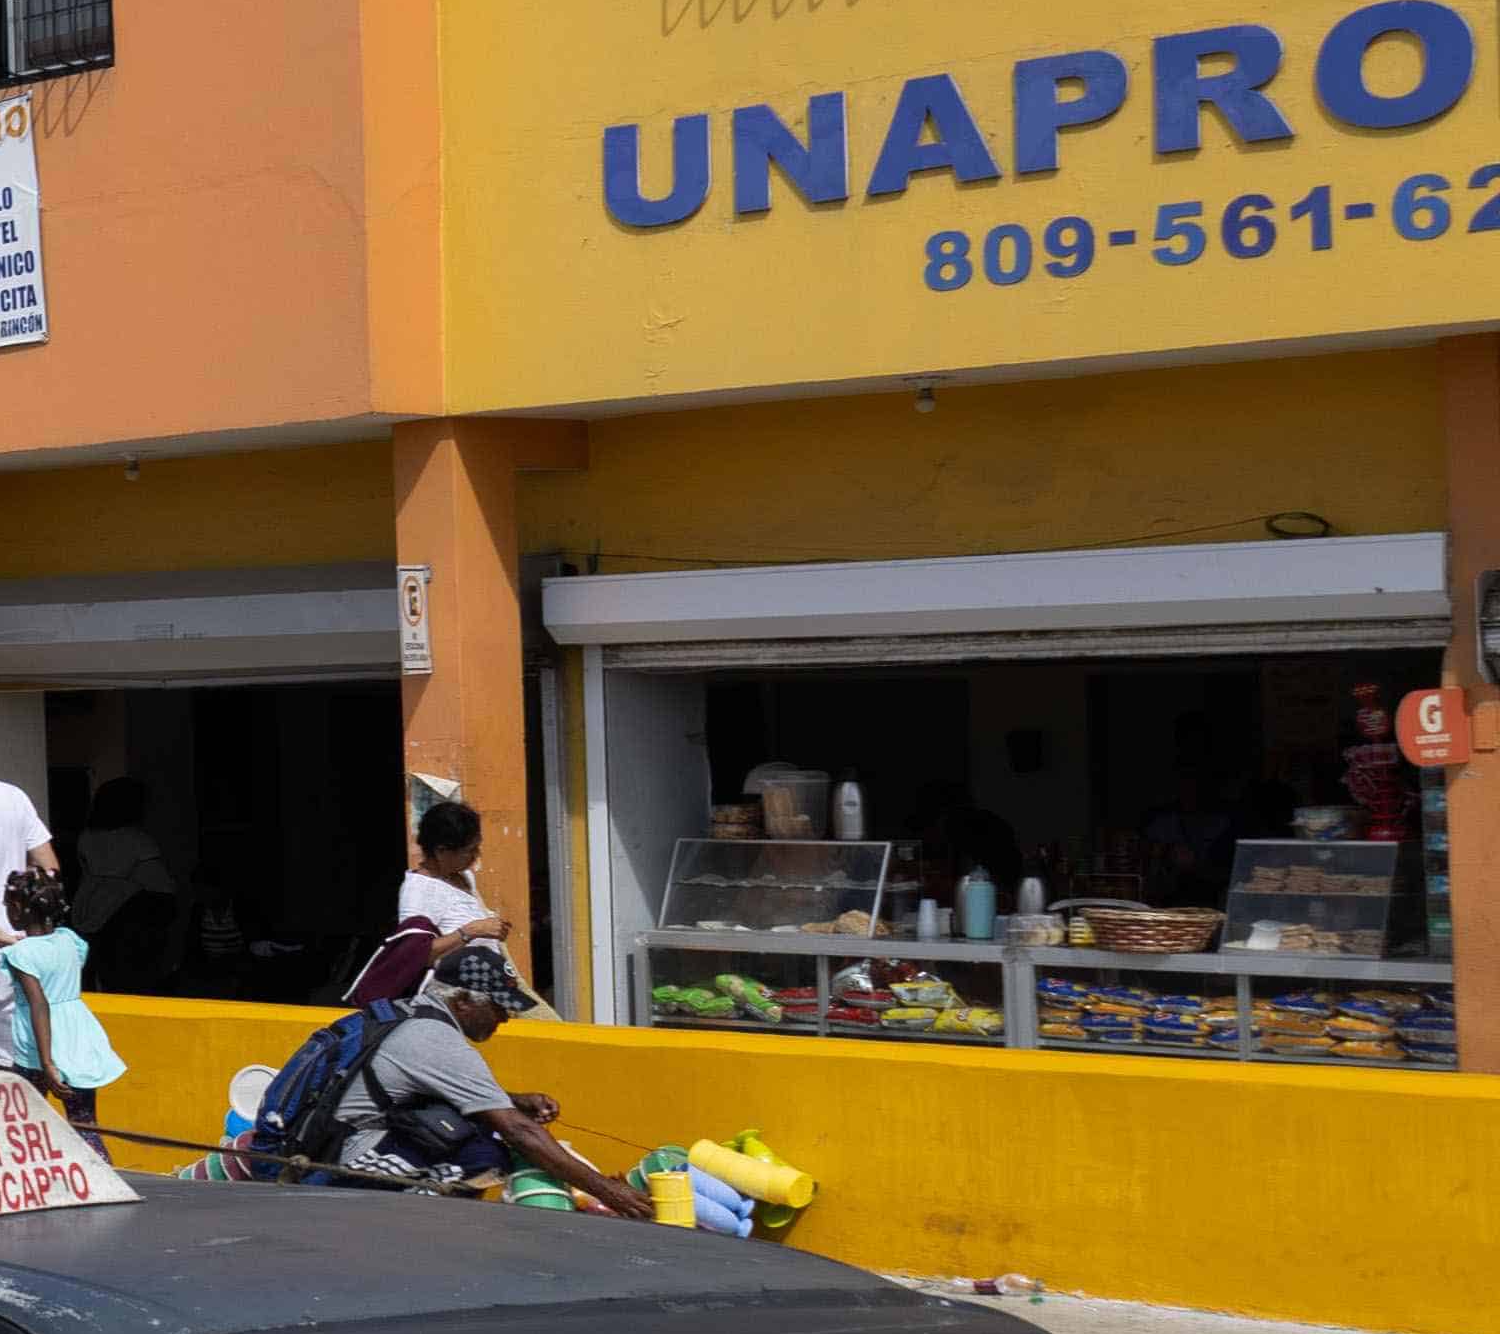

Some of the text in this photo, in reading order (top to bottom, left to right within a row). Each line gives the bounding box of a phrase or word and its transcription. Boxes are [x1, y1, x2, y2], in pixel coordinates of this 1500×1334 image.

[602, 0, 1500, 229] UNAPRO
[1419, 694, 1443, 733] G
[5, 1120, 63, 1165] SRL
